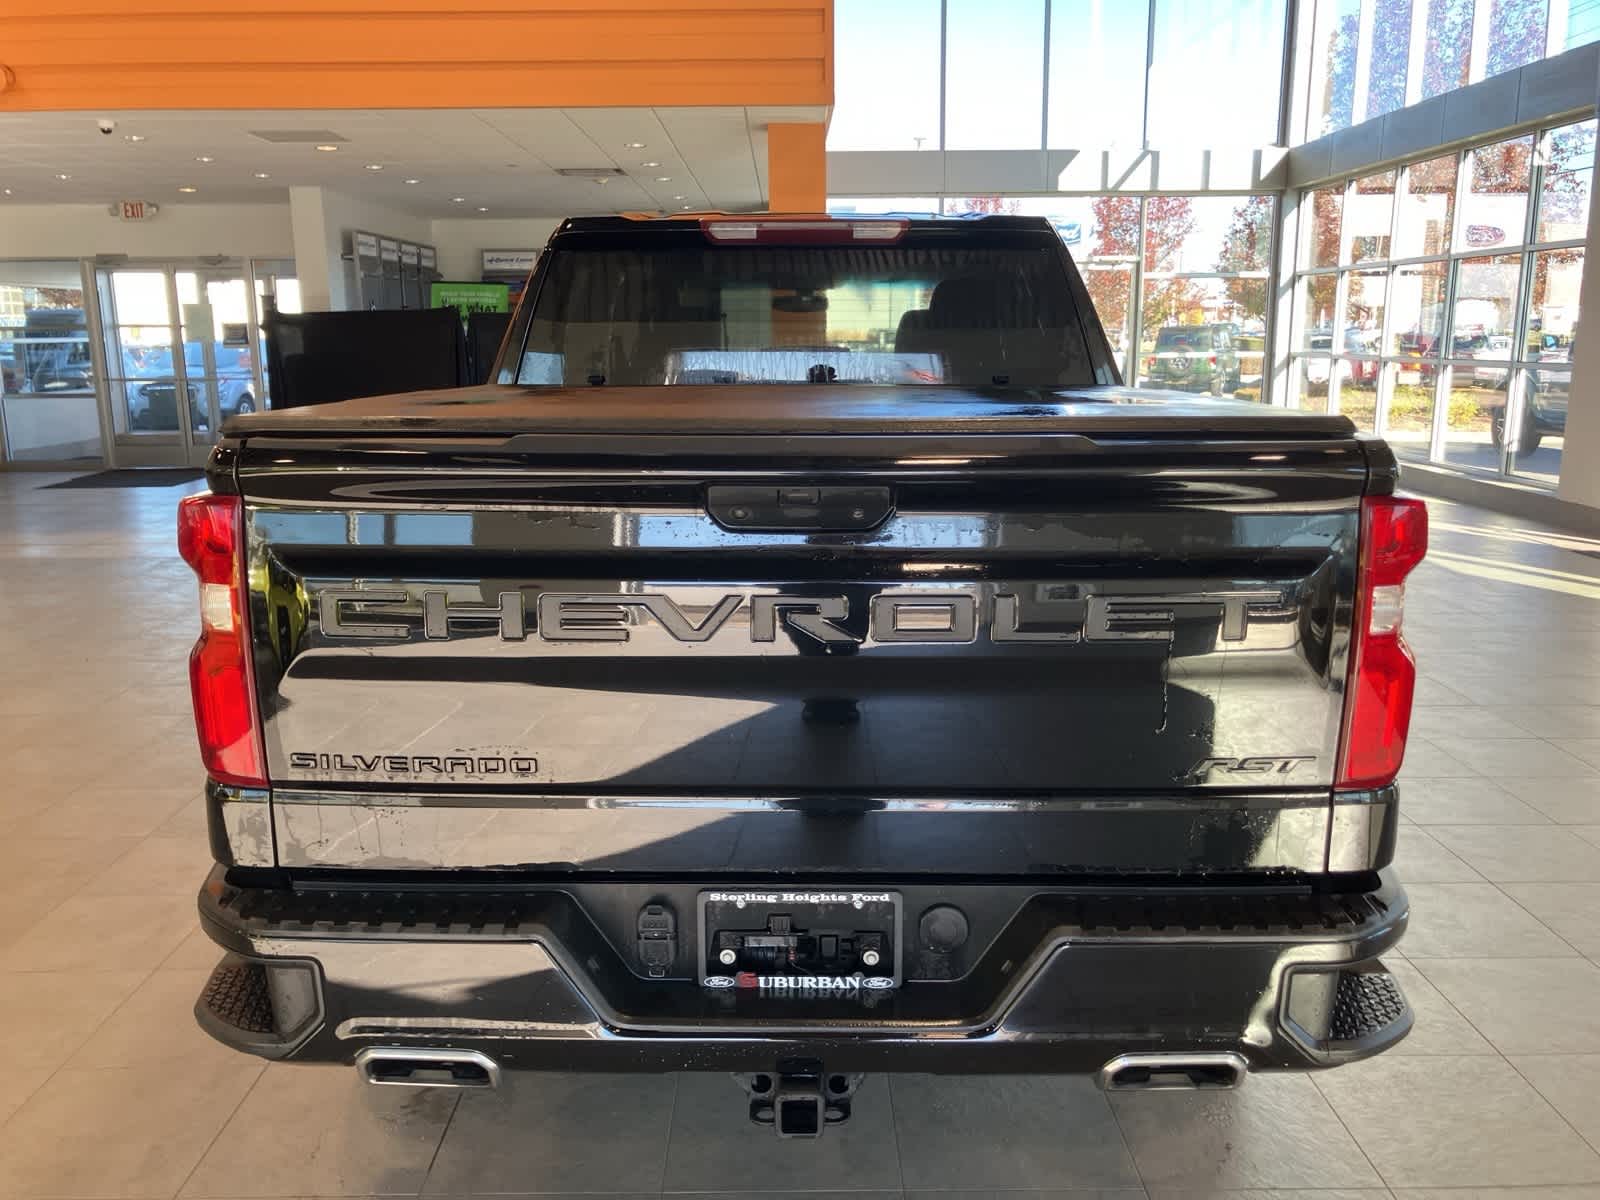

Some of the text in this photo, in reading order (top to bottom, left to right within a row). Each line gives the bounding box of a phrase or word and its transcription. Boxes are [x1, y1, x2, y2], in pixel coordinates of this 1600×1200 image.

[123, 202, 144, 218] EXIT
[319, 589, 1284, 643] CHEVROLET
[290, 752, 538, 774] SILVERADO
[1192, 755, 1317, 774] RST
[709, 893, 890, 903] Sterling Heights Ford
[737, 972, 861, 988] SUBURBAN
